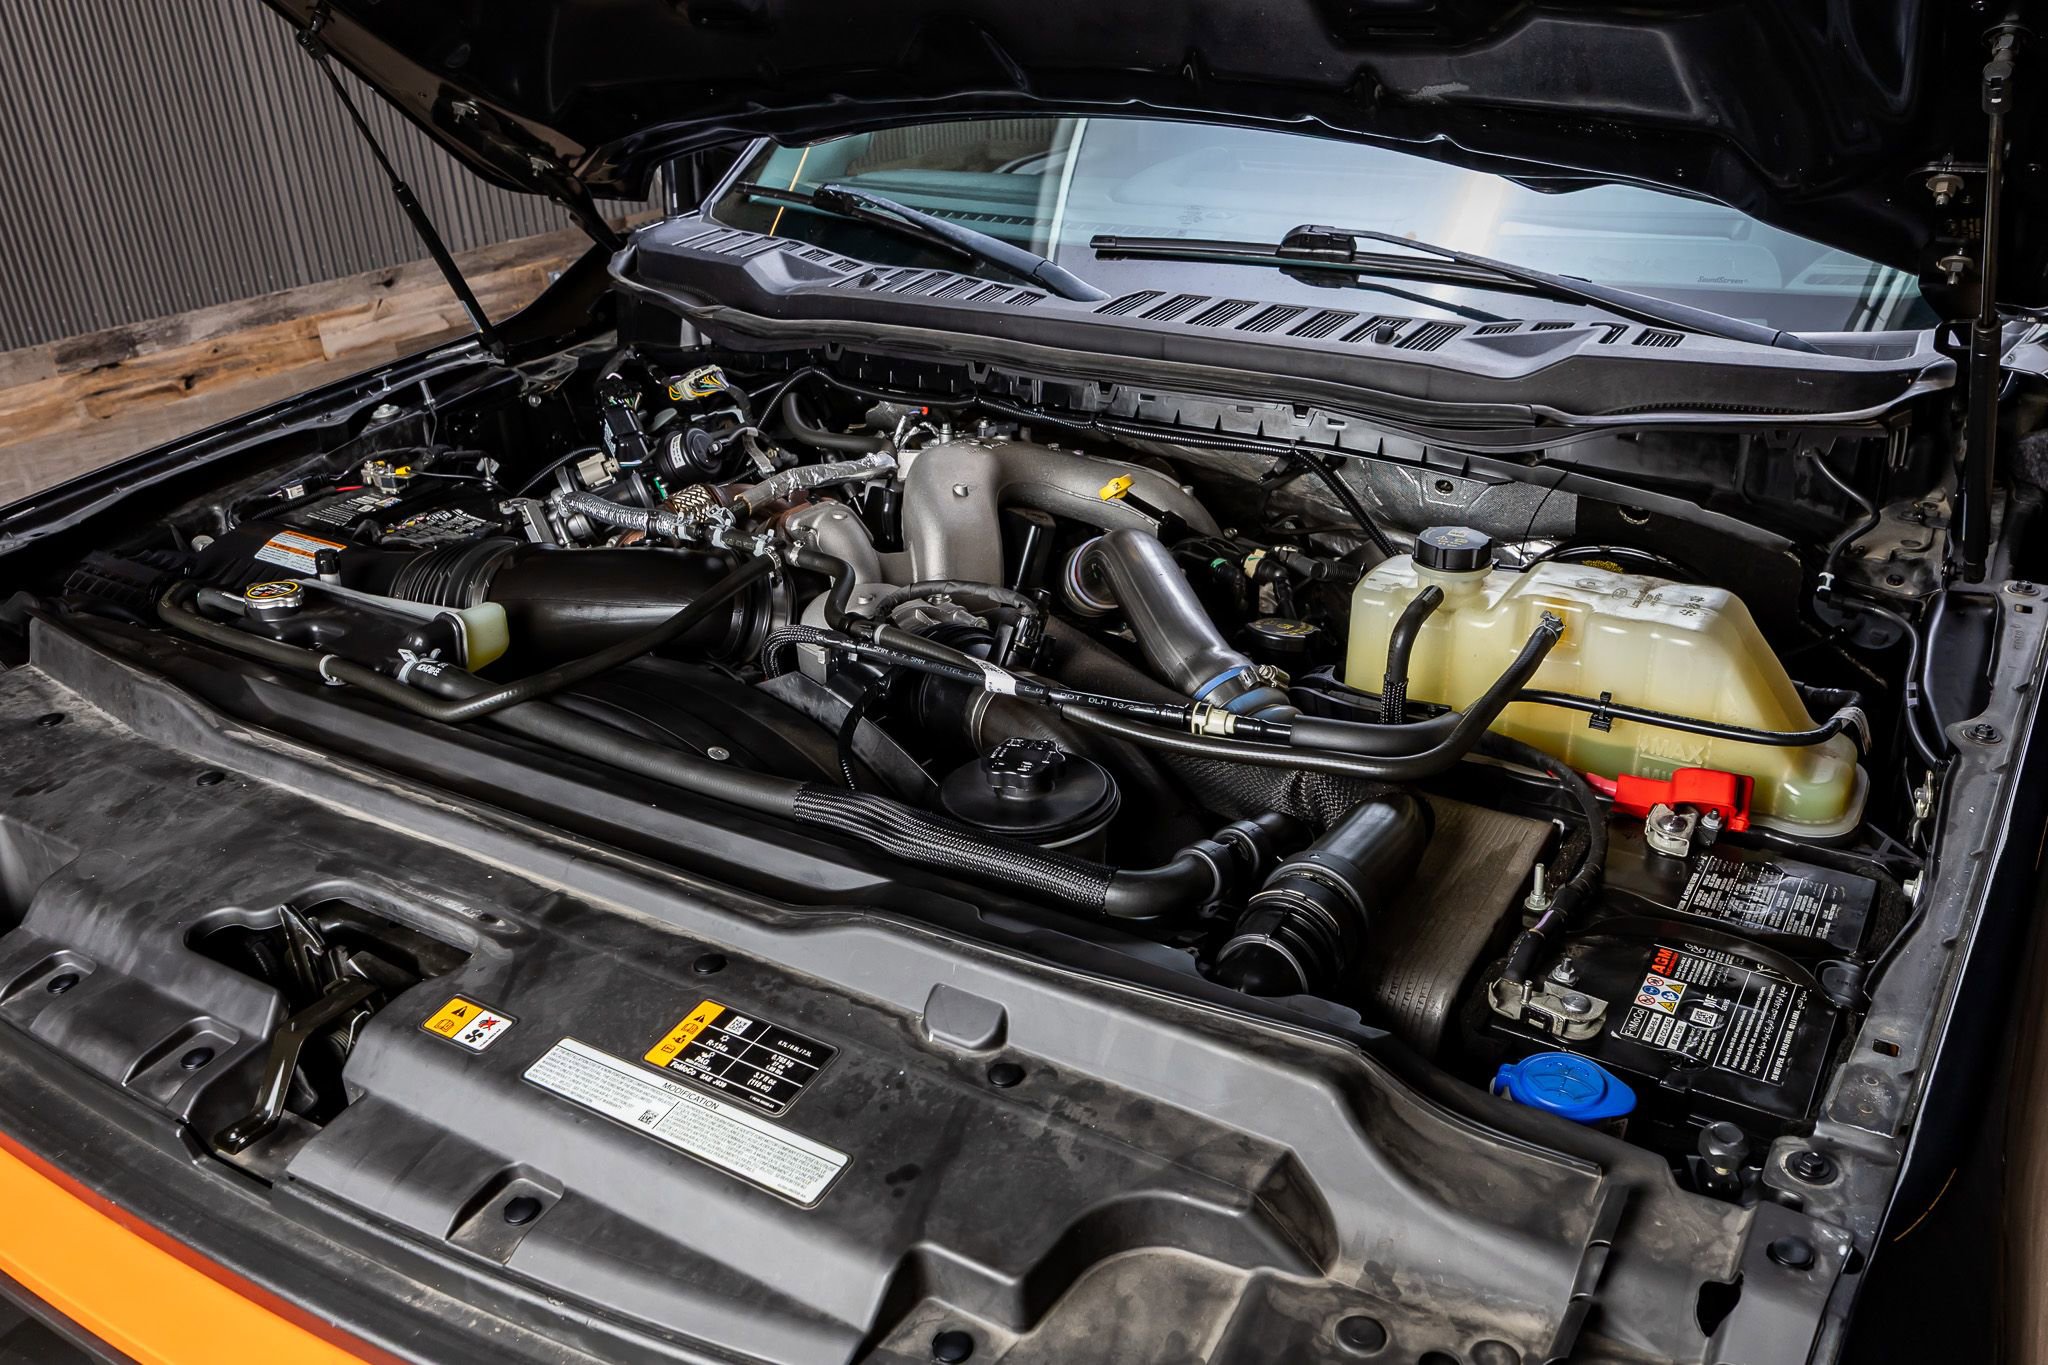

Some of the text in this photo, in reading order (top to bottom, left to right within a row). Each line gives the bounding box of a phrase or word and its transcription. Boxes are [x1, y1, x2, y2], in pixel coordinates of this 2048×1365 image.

[1650, 736, 1705, 764] MAX
[1652, 949, 1672, 973] AGM
[1704, 994, 1716, 1007] MF
[1625, 1010, 1644, 1037] FoMoCo
[706, 1039, 729, 1053] R-134a
[694, 1055, 710, 1065] PAG
[669, 1061, 697, 1076] FoMoCo
[700, 1073, 713, 1083] SAE
[753, 1071, 764, 1081] 3.7
[662, 1082, 719, 1111] MODIFICATION
